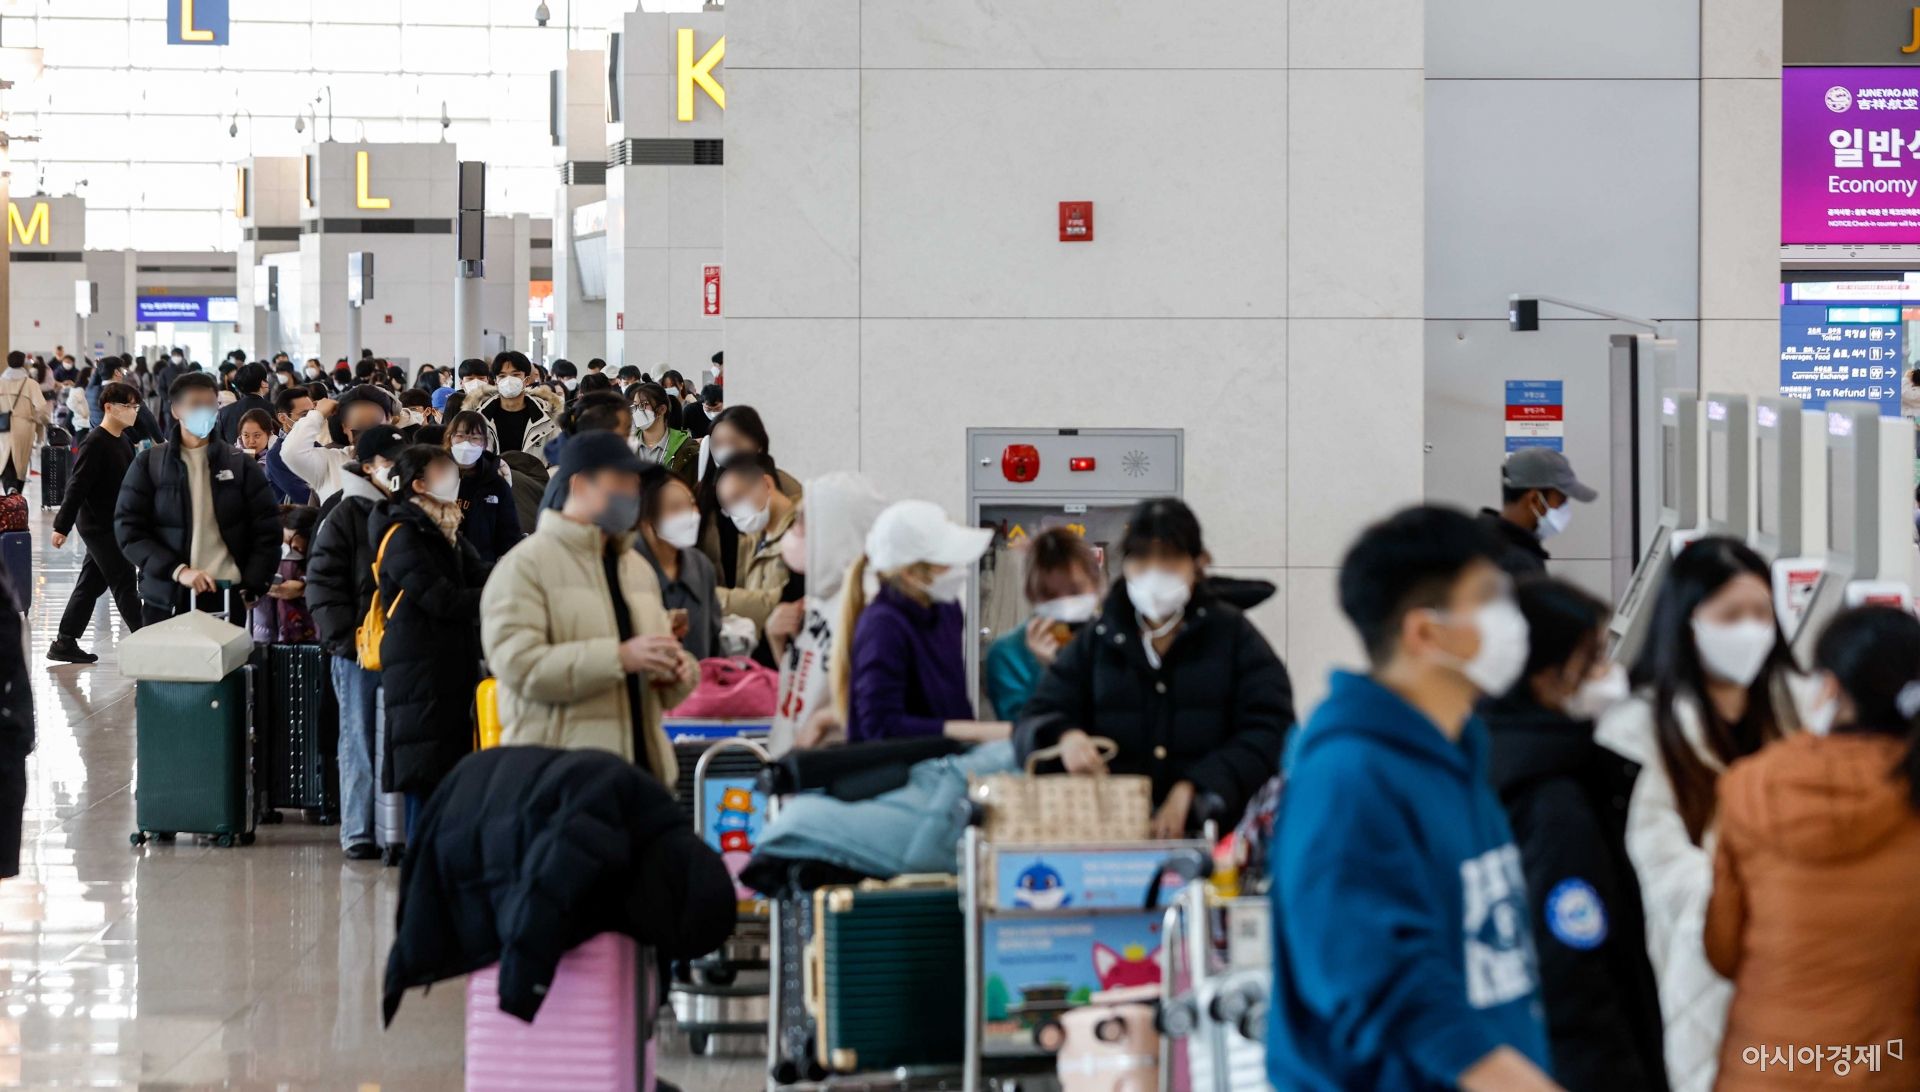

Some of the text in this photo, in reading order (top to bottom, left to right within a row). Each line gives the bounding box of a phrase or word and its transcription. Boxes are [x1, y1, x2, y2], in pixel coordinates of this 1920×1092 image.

[181, 0, 214, 41] L
[1901, 6, 1920, 53] J
[676, 28, 726, 122] K
[1857, 88, 1919, 97] JUNEYAO AIR
[1856, 98, 1919, 110] 吉祥航空
[356, 151, 391, 209] L
[1828, 175, 1918, 197] Economy
[8, 202, 50, 246] M
[1781, 352, 1831, 362] Beverages, Food
[1791, 372, 1849, 381] Currency Exchange
[1815, 388, 1831, 398] Tax
[1833, 388, 1866, 398] Refund
